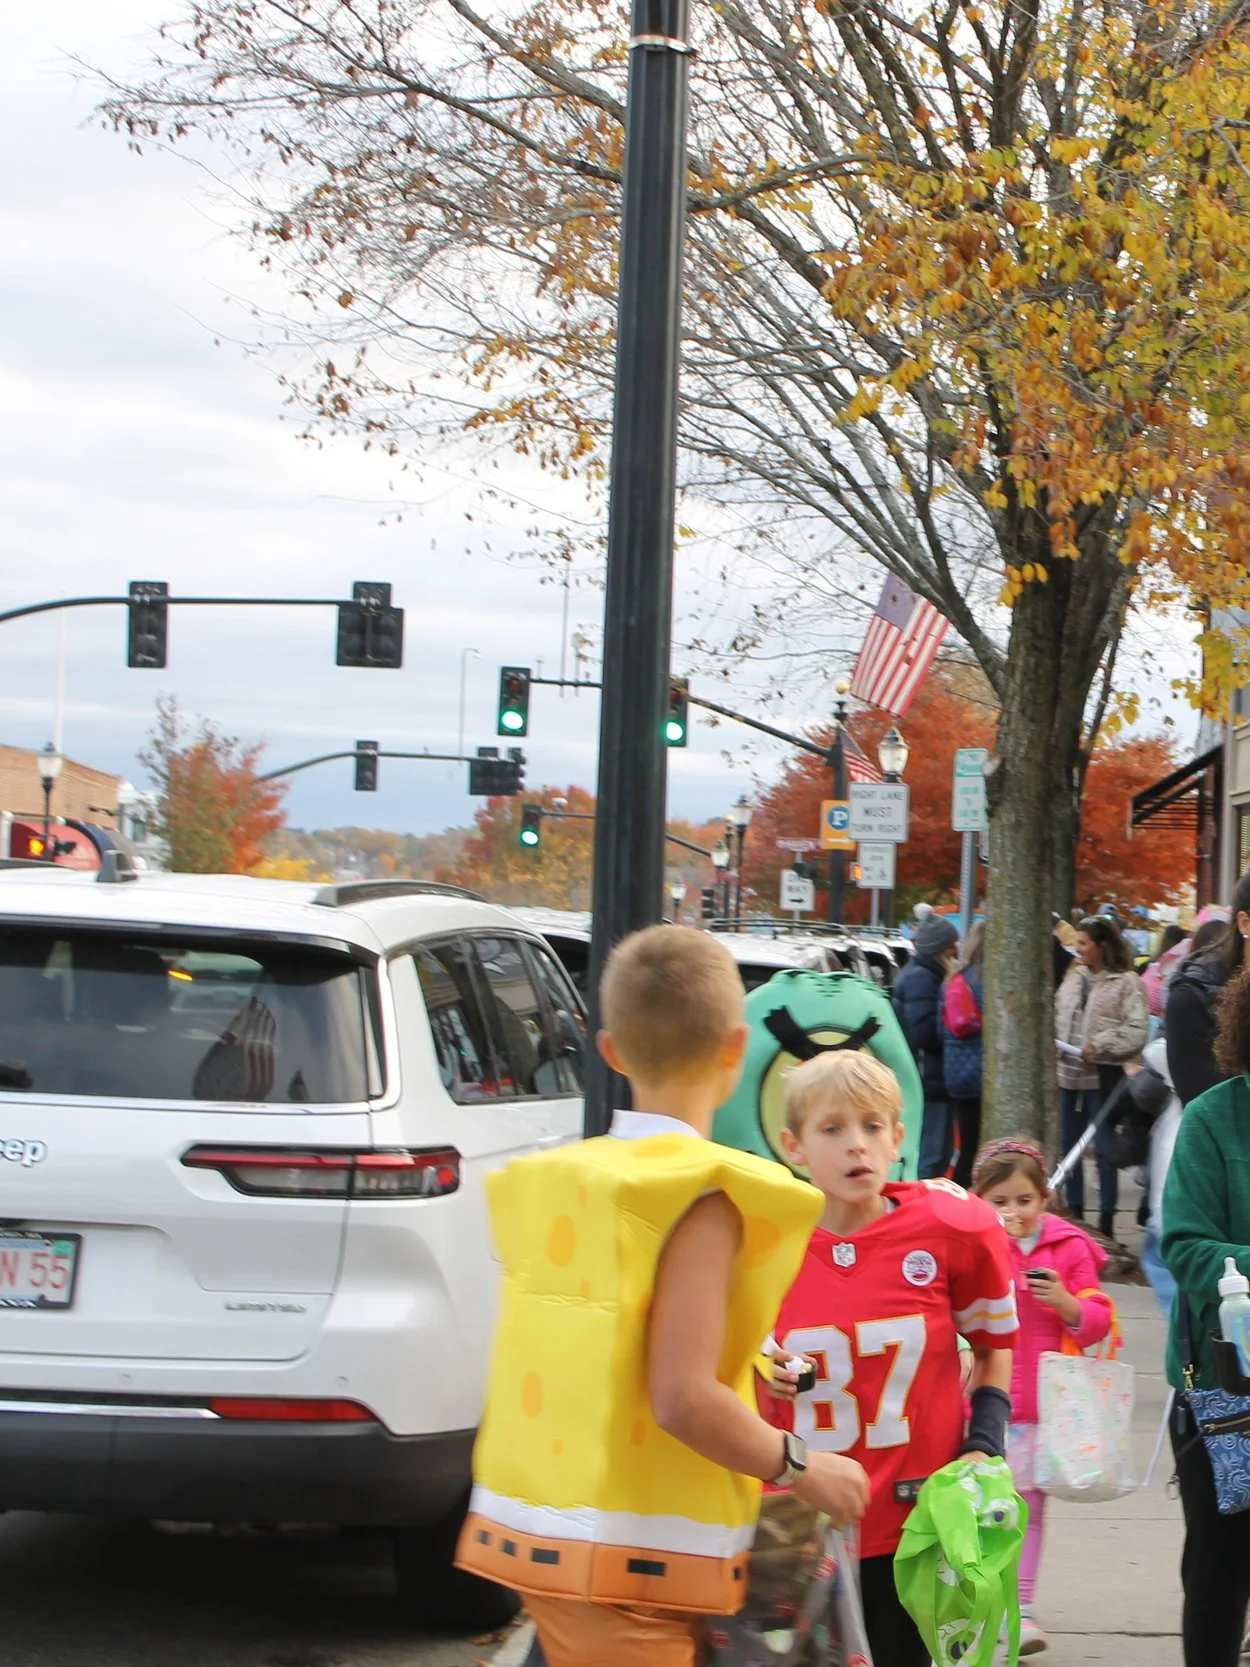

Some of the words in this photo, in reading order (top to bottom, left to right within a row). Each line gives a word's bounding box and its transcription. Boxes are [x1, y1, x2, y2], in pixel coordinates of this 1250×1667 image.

[851, 790, 877, 800] RIGHT
[880, 791, 905, 801] LANE
[831, 810, 849, 827] P
[863, 806, 893, 818] MUST
[852, 823, 874, 833] TURN
[877, 824, 903, 834] RIGHT
[29, 1251, 69, 1290] 55
[782, 1313, 927, 1454] 87
